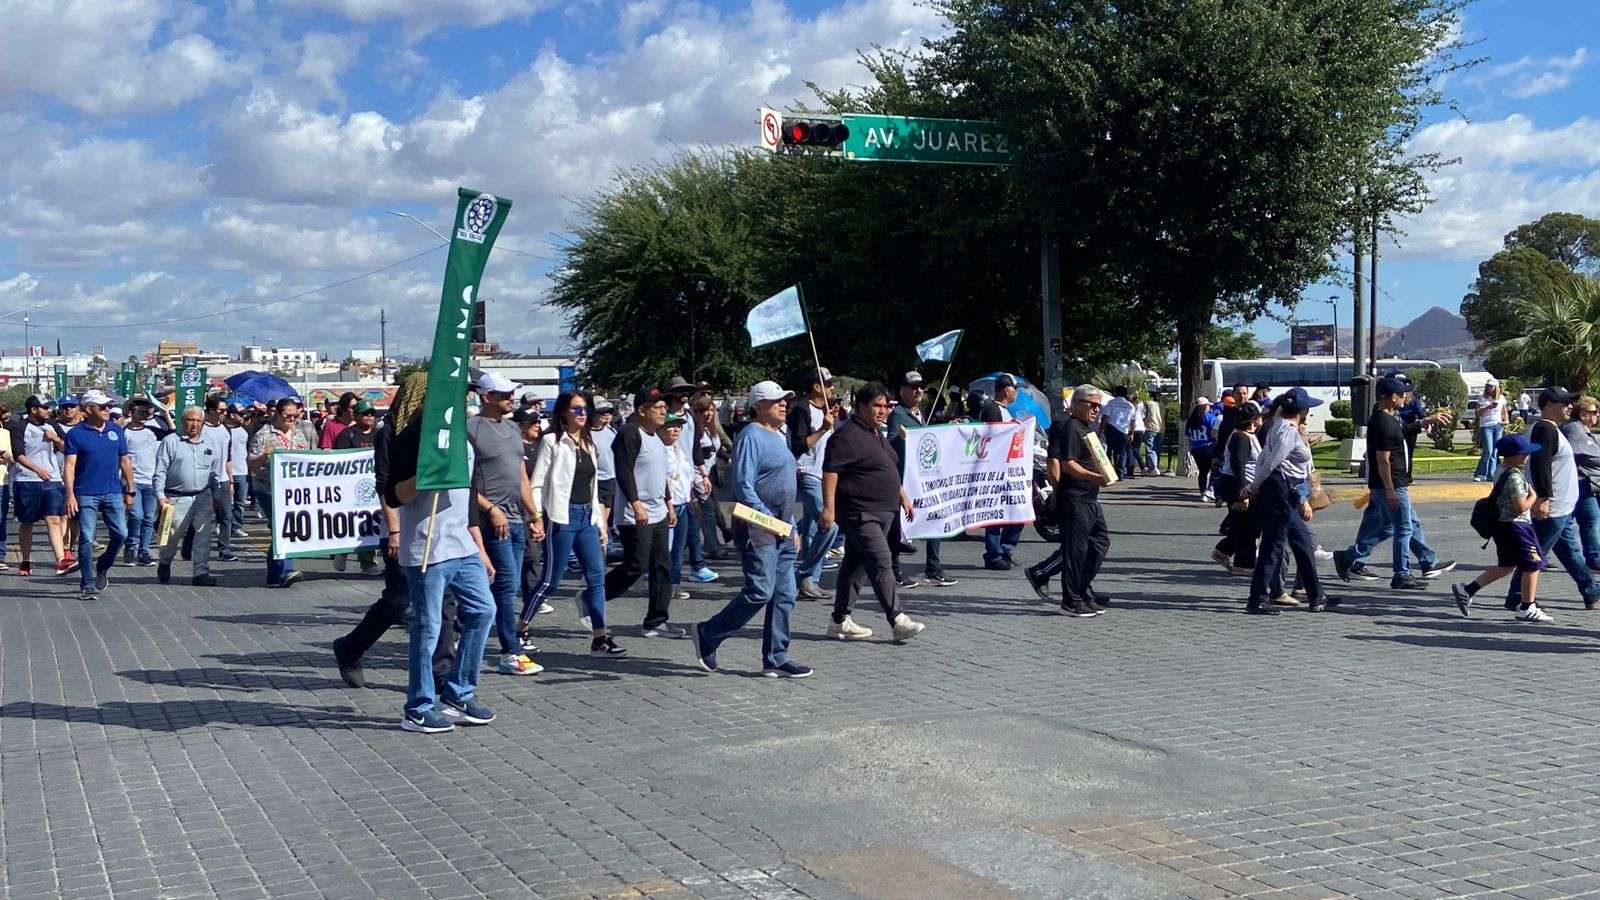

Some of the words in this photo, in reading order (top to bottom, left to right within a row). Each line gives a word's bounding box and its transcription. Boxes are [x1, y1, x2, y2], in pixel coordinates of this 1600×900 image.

[863, 127, 899, 149] AV.
[913, 129, 1009, 154] JUAREZ
[988, 471, 995, 482] DE
[996, 471, 1005, 481] LA
[285, 487, 311, 506] POR
[317, 486, 342, 504] LAS
[967, 486, 978, 497] CON
[979, 485, 989, 496] LOS
[975, 498, 993, 509] MONTE
[282, 510, 312, 542] 40
[318, 509, 382, 540] horas
